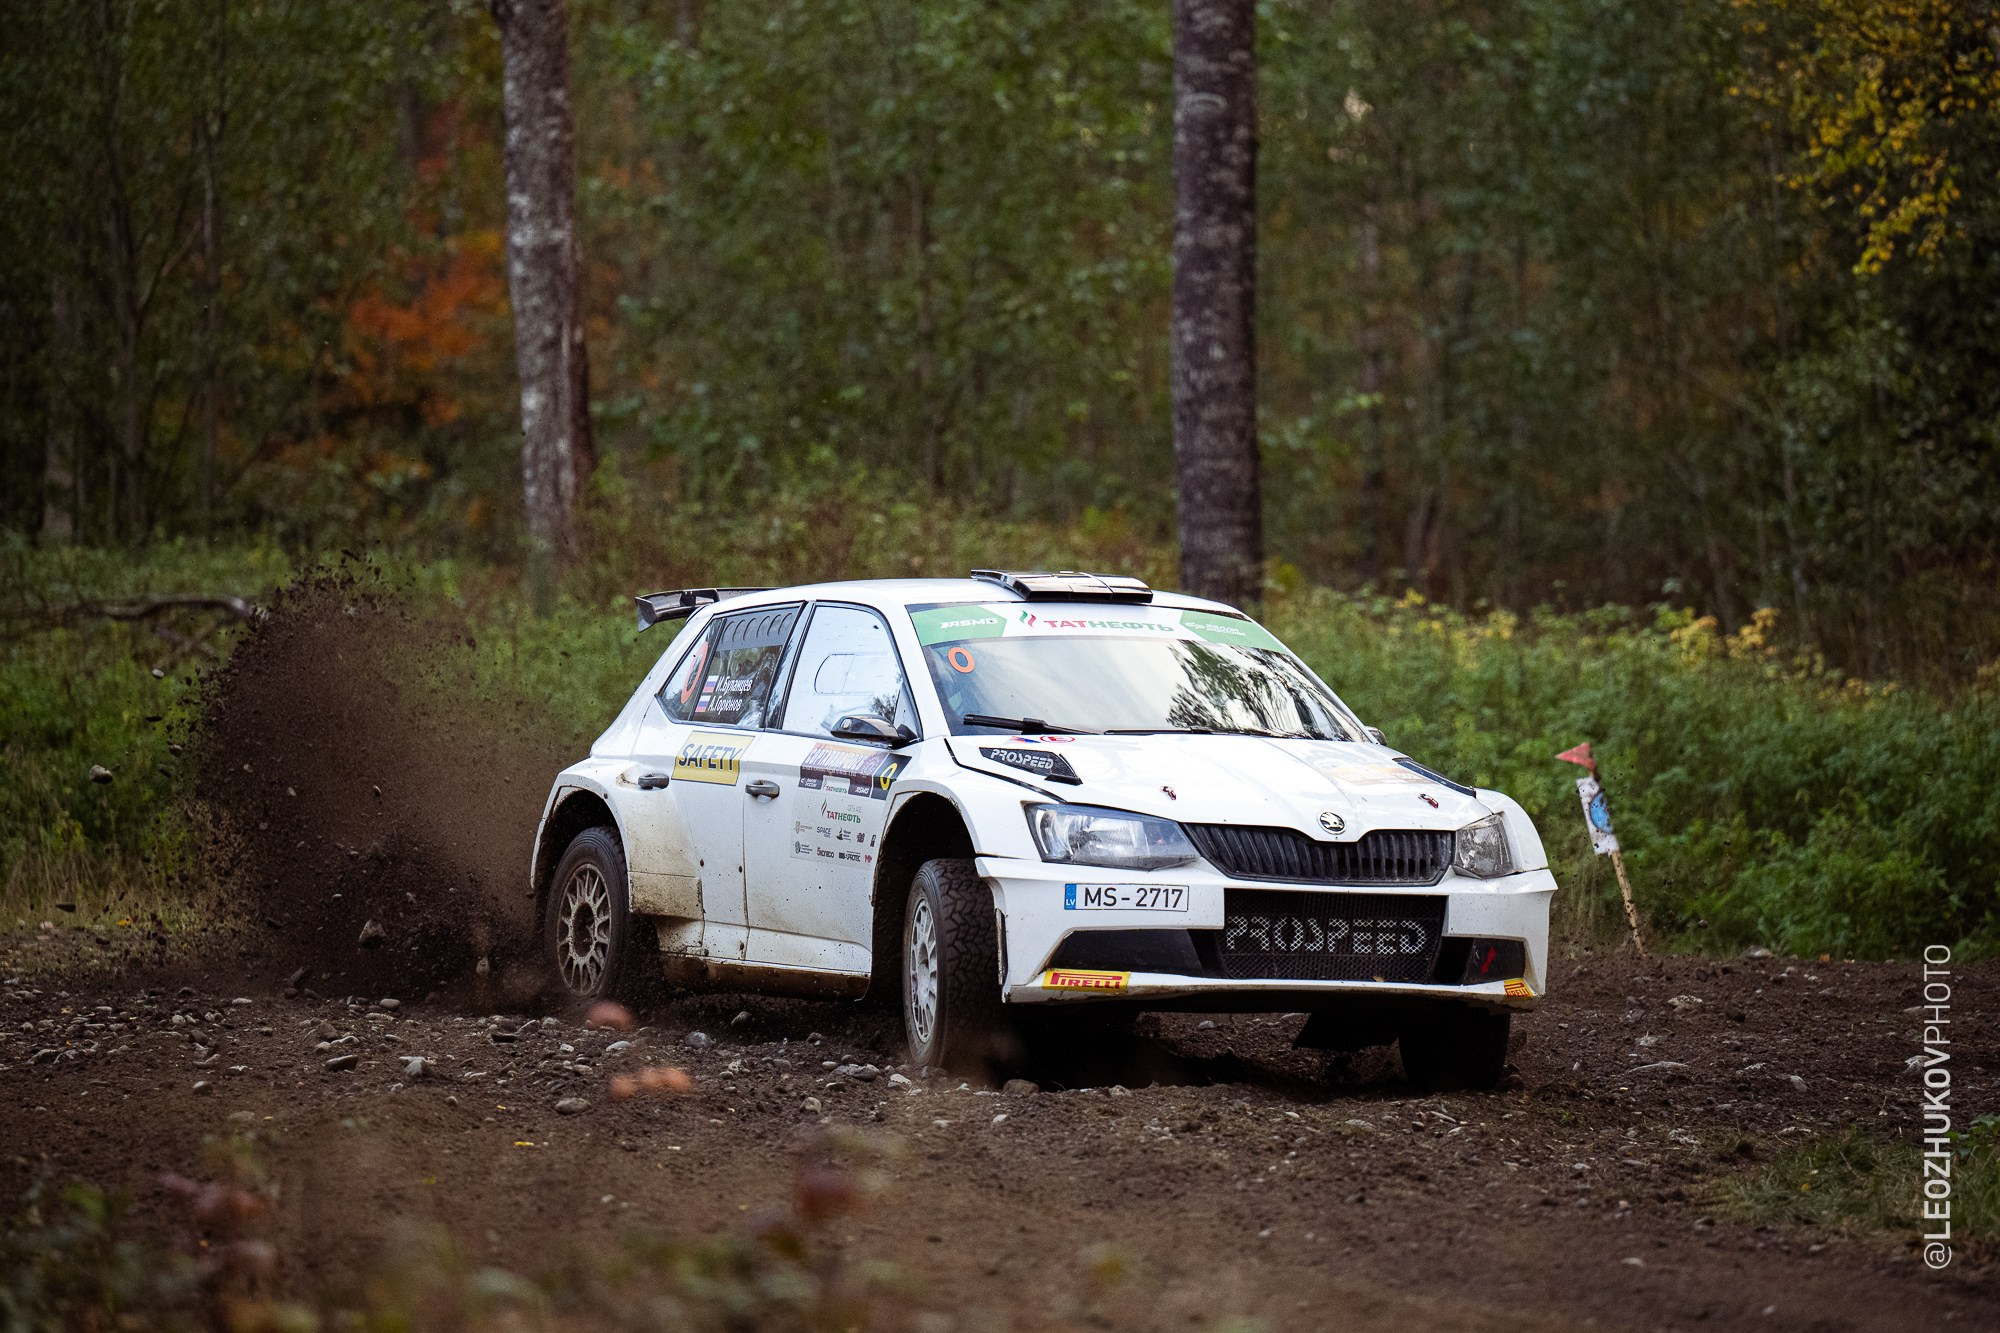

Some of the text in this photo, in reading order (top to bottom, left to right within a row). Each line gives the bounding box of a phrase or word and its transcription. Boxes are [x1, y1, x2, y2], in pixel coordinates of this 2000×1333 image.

[1043, 620, 1174, 632] ТАТНЕФТЬ
[707, 695, 743, 716] А.Горюнов
[678, 743, 743, 771] SAFETY
[990, 748, 1054, 769] PROSPEED
[880, 762, 898, 791] 0
[825, 785, 848, 794] ТАТНЕФТЬ
[826, 810, 862, 824] ТАТНЕФТЬ
[816, 826, 832, 836] SPACE
[1065, 898, 1076, 906] LV
[1084, 887, 1183, 908] MS-2717
[1225, 915, 1428, 955] PROSPEED
[1050, 972, 1123, 989] PIRELLI
